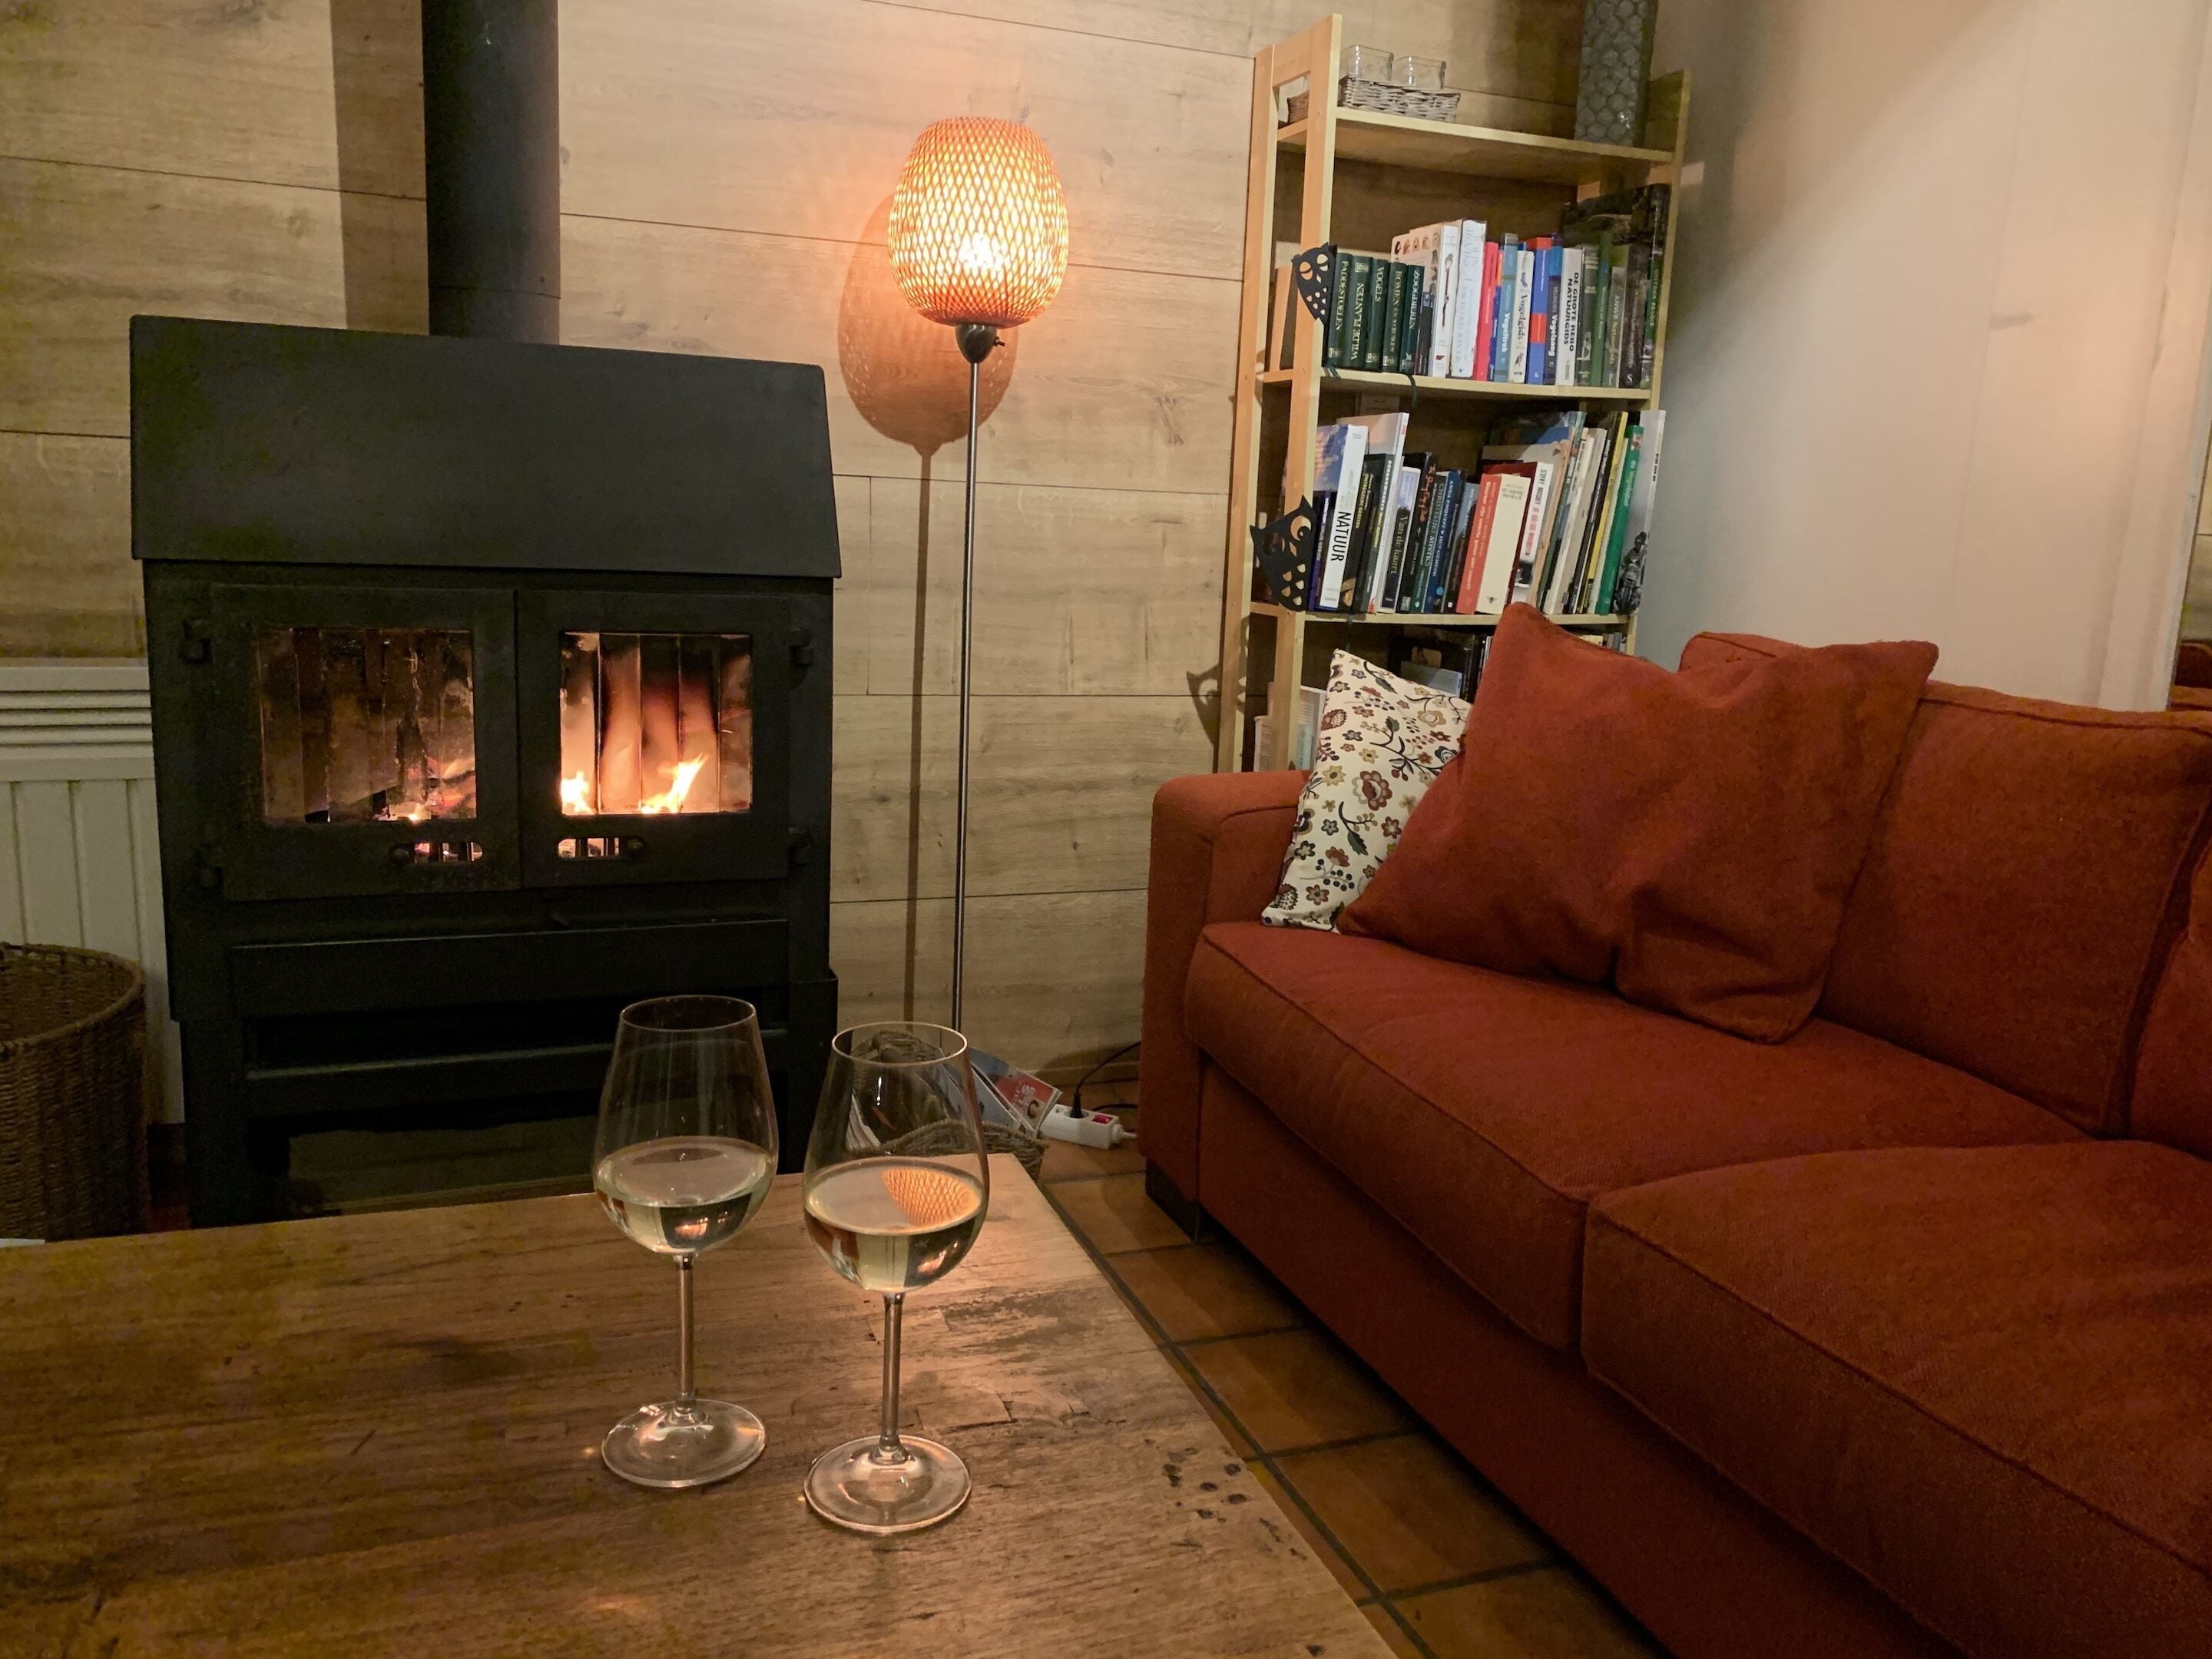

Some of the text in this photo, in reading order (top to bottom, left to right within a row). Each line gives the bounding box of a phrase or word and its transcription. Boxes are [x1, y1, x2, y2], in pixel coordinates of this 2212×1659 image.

[1335, 261, 1349, 331] PADDESTOELEN
[1374, 267, 1385, 302] VOGELS
[1392, 270, 1402, 306] BOMEN
[1409, 270, 1420, 329] ZOOGDIEREN
[1574, 272, 1579, 283] DE
[1351, 283, 1365, 360] WILDE PLANTEN
[1502, 313, 1511, 353] Vogeltrek
[1518, 294, 1528, 340] Vogelgids
[1564, 278, 1573, 345] NATUURGIDS
[1548, 314, 1558, 356] Vogelzang
[1609, 322, 1618, 364] Natuurgids
[1330, 511, 1353, 561] NATUUR
[1391, 516, 1409, 575] Van de kaart
